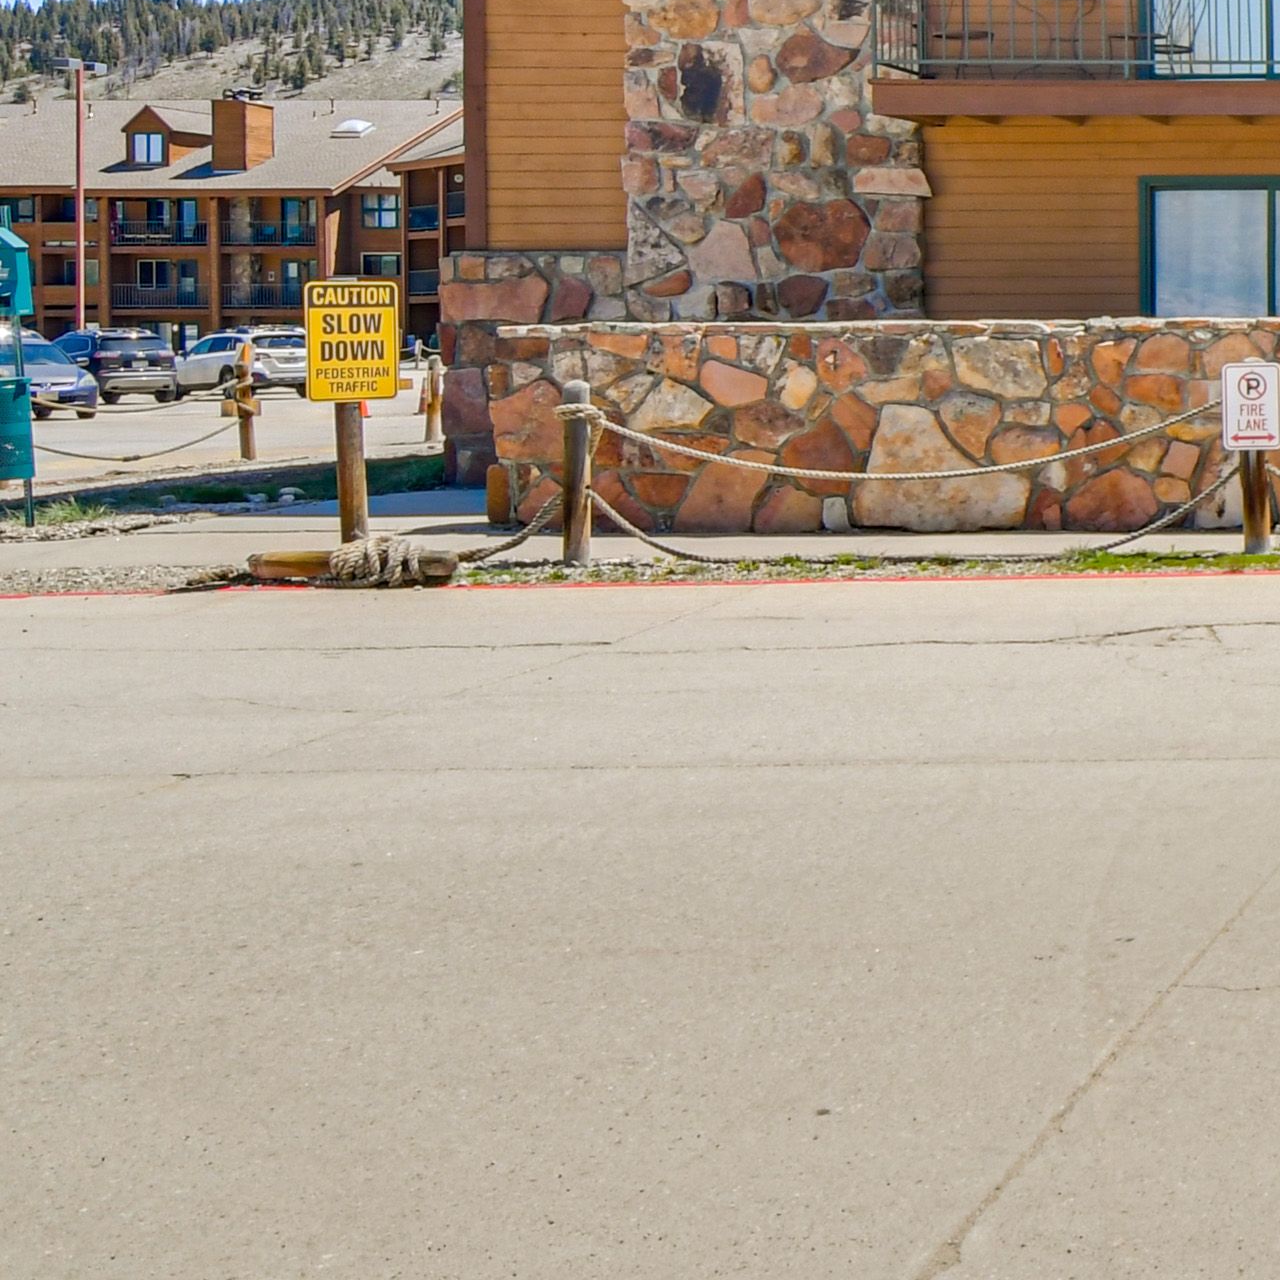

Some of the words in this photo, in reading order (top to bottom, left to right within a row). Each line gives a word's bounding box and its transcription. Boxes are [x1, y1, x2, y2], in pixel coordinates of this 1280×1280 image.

[312, 286, 391, 305] CAUTION
[322, 313, 382, 335] SLOW
[320, 340, 385, 362] DOWN
[315, 366, 390, 380] PEDESTRIAN
[328, 380, 379, 393] TRAFFIC
[1239, 403, 1266, 417] FIRE
[1237, 418, 1268, 432] LANE
